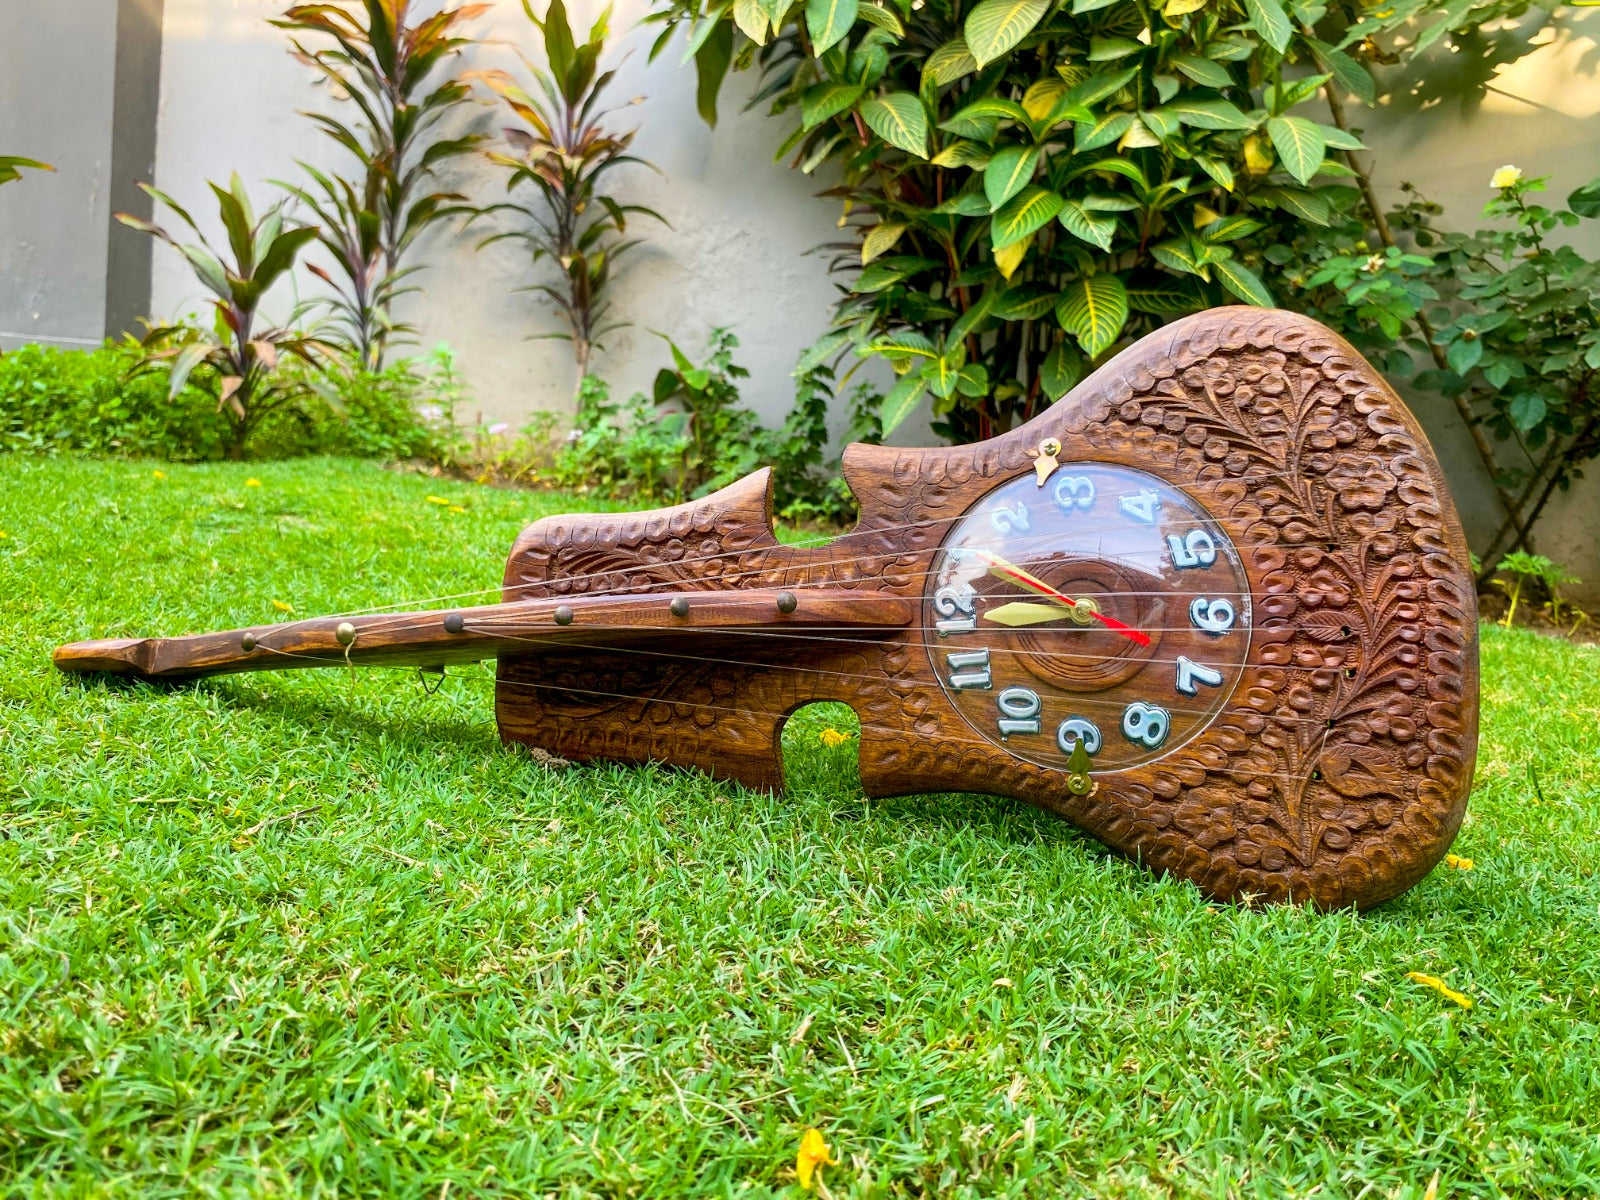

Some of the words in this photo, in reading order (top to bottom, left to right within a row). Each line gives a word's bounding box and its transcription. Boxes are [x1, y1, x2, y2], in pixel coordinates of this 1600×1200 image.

[1054, 476, 1095, 509] 3
[1119, 489, 1162, 522] 4
[990, 502, 1030, 533] 2
[1167, 530, 1216, 569] 5
[934, 585, 976, 637] 12
[1190, 597, 1235, 635] 6
[947, 647, 991, 692] 11
[1176, 656, 1223, 697] 7
[997, 687, 1041, 740] 10
[1122, 702, 1171, 748] 8
[1056, 716, 1102, 755] 9
